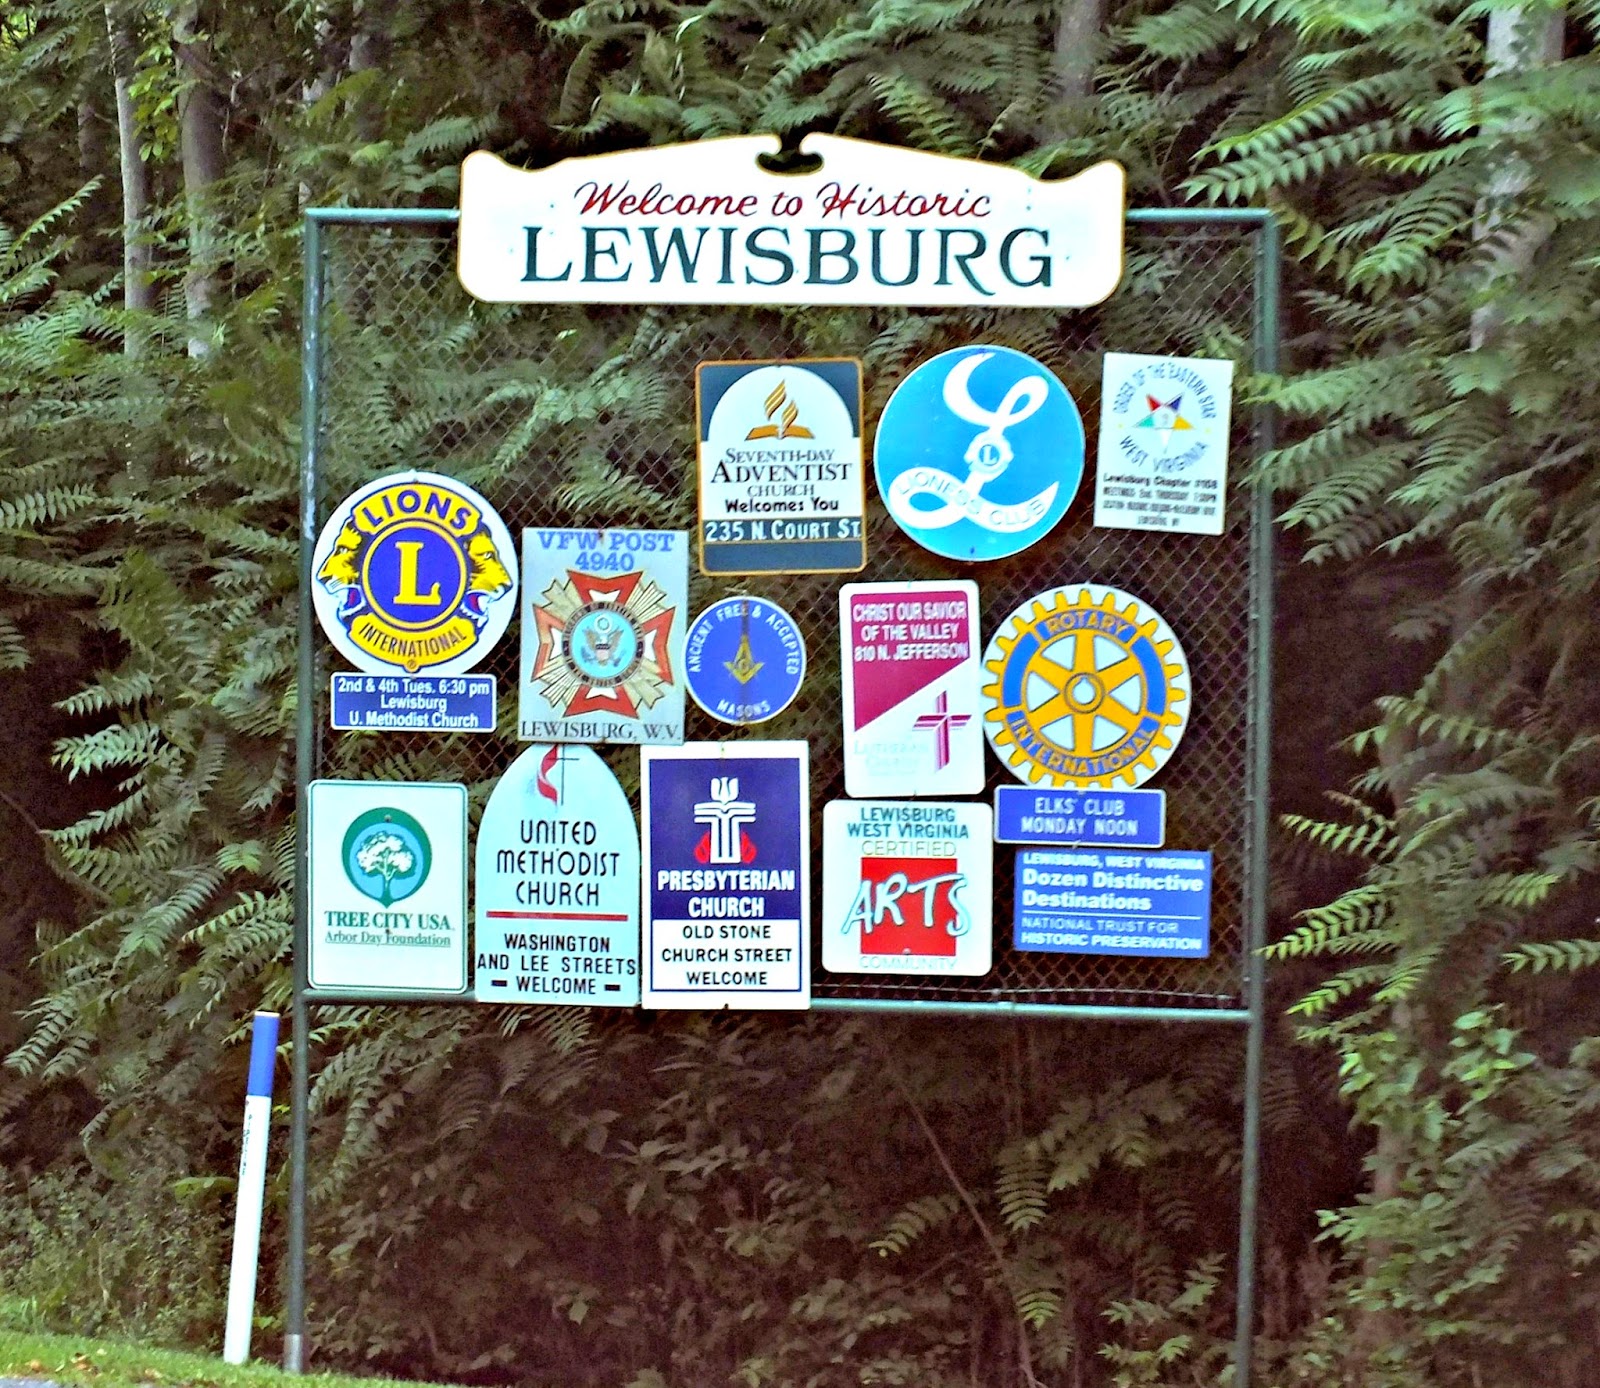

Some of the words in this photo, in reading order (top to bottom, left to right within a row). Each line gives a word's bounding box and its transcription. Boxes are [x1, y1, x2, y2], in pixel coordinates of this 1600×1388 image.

[574, 182, 757, 217] Welcome
[773, 185, 802, 216] to
[816, 181, 990, 219] Historic
[520, 225, 1053, 296] LEWISBURG
[1119, 435, 1149, 467] WEST
[711, 460, 852, 483] ADVENTIST
[747, 484, 815, 497] CHURCH
[361, 490, 472, 529] LIONS
[725, 498, 804, 513] Welcomes
[811, 497, 839, 511] You
[536, 531, 602, 549] VFW
[609, 532, 675, 552] POST
[705, 521, 744, 542] 235
[575, 552, 634, 571] 4940
[393, 541, 442, 606] L
[853, 603, 895, 622] CHRIST
[896, 602, 923, 621] OUR
[923, 601, 967, 620] SAVIOR
[861, 625, 880, 642] OF
[881, 624, 908, 640] THE
[909, 622, 960, 640] VALLEY
[1046, 611, 1131, 639] ROTARY
[358, 622, 468, 658] INTERNATIONAL
[688, 619, 714, 673] ANCIENT
[752, 605, 762, 618] &
[765, 613, 801, 675] ACCEPTED
[893, 642, 969, 660] JEFFERSON
[338, 679, 362, 694] 2nd
[365, 680, 376, 693] &
[378, 680, 399, 694] 4th
[401, 680, 436, 695] Tues.
[438, 681, 466, 695] 6:30
[469, 684, 490, 698] pm
[380, 695, 448, 713] Lewisburg
[717, 699, 771, 718] MASONS
[349, 712, 363, 725] U.
[366, 711, 429, 728] Methodist
[431, 713, 479, 728] Church
[521, 721, 638, 741] LEWISBURG,
[1011, 718, 1156, 776] INTERNATIONAL
[860, 807, 956, 822] LEWISBURG
[1084, 798, 1125, 815] CLUB
[520, 819, 597, 845] UNITED
[847, 823, 892, 838] WEST
[898, 823, 969, 839] VIRGINIA
[1021, 816, 1087, 835] MONDAY
[1094, 818, 1138, 836] NOON
[861, 840, 957, 857] CERTIFIED
[497, 850, 620, 876] METHODIST
[1104, 855, 1143, 869] WEST
[657, 870, 796, 891] PRESBYTERIAN
[1022, 868, 1088, 887] Dozen
[1092, 871, 1204, 892] Distinctive
[516, 881, 600, 906] CHURCH
[1022, 890, 1152, 911] Destinations
[688, 897, 765, 918] CHURCH
[840, 872, 972, 937] ARTS
[324, 911, 370, 927] TREE
[372, 912, 413, 929] CITY
[418, 913, 451, 931] USA
[1022, 917, 1093, 931] NATIONAL
[1097, 920, 1145, 933] TRUST
[1147, 922, 1179, 933] FOR
[325, 930, 357, 943] Arbor
[361, 931, 382, 946] Day
[386, 932, 451, 946] Foundation
[682, 925, 714, 939] OLD
[719, 925, 772, 939] STONE
[1021, 932, 1088, 946] HISTORIC
[1091, 935, 1202, 950] PRESERVATION
[504, 933, 610, 953] WASHINGTON
[477, 953, 510, 970] AND
[521, 954, 549, 972] LEE
[561, 957, 636, 975] STREETS
[661, 948, 729, 962] CHURCH
[734, 948, 793, 962] STREET
[516, 976, 596, 994] WELCOME
[686, 971, 768, 985] WELCOME
